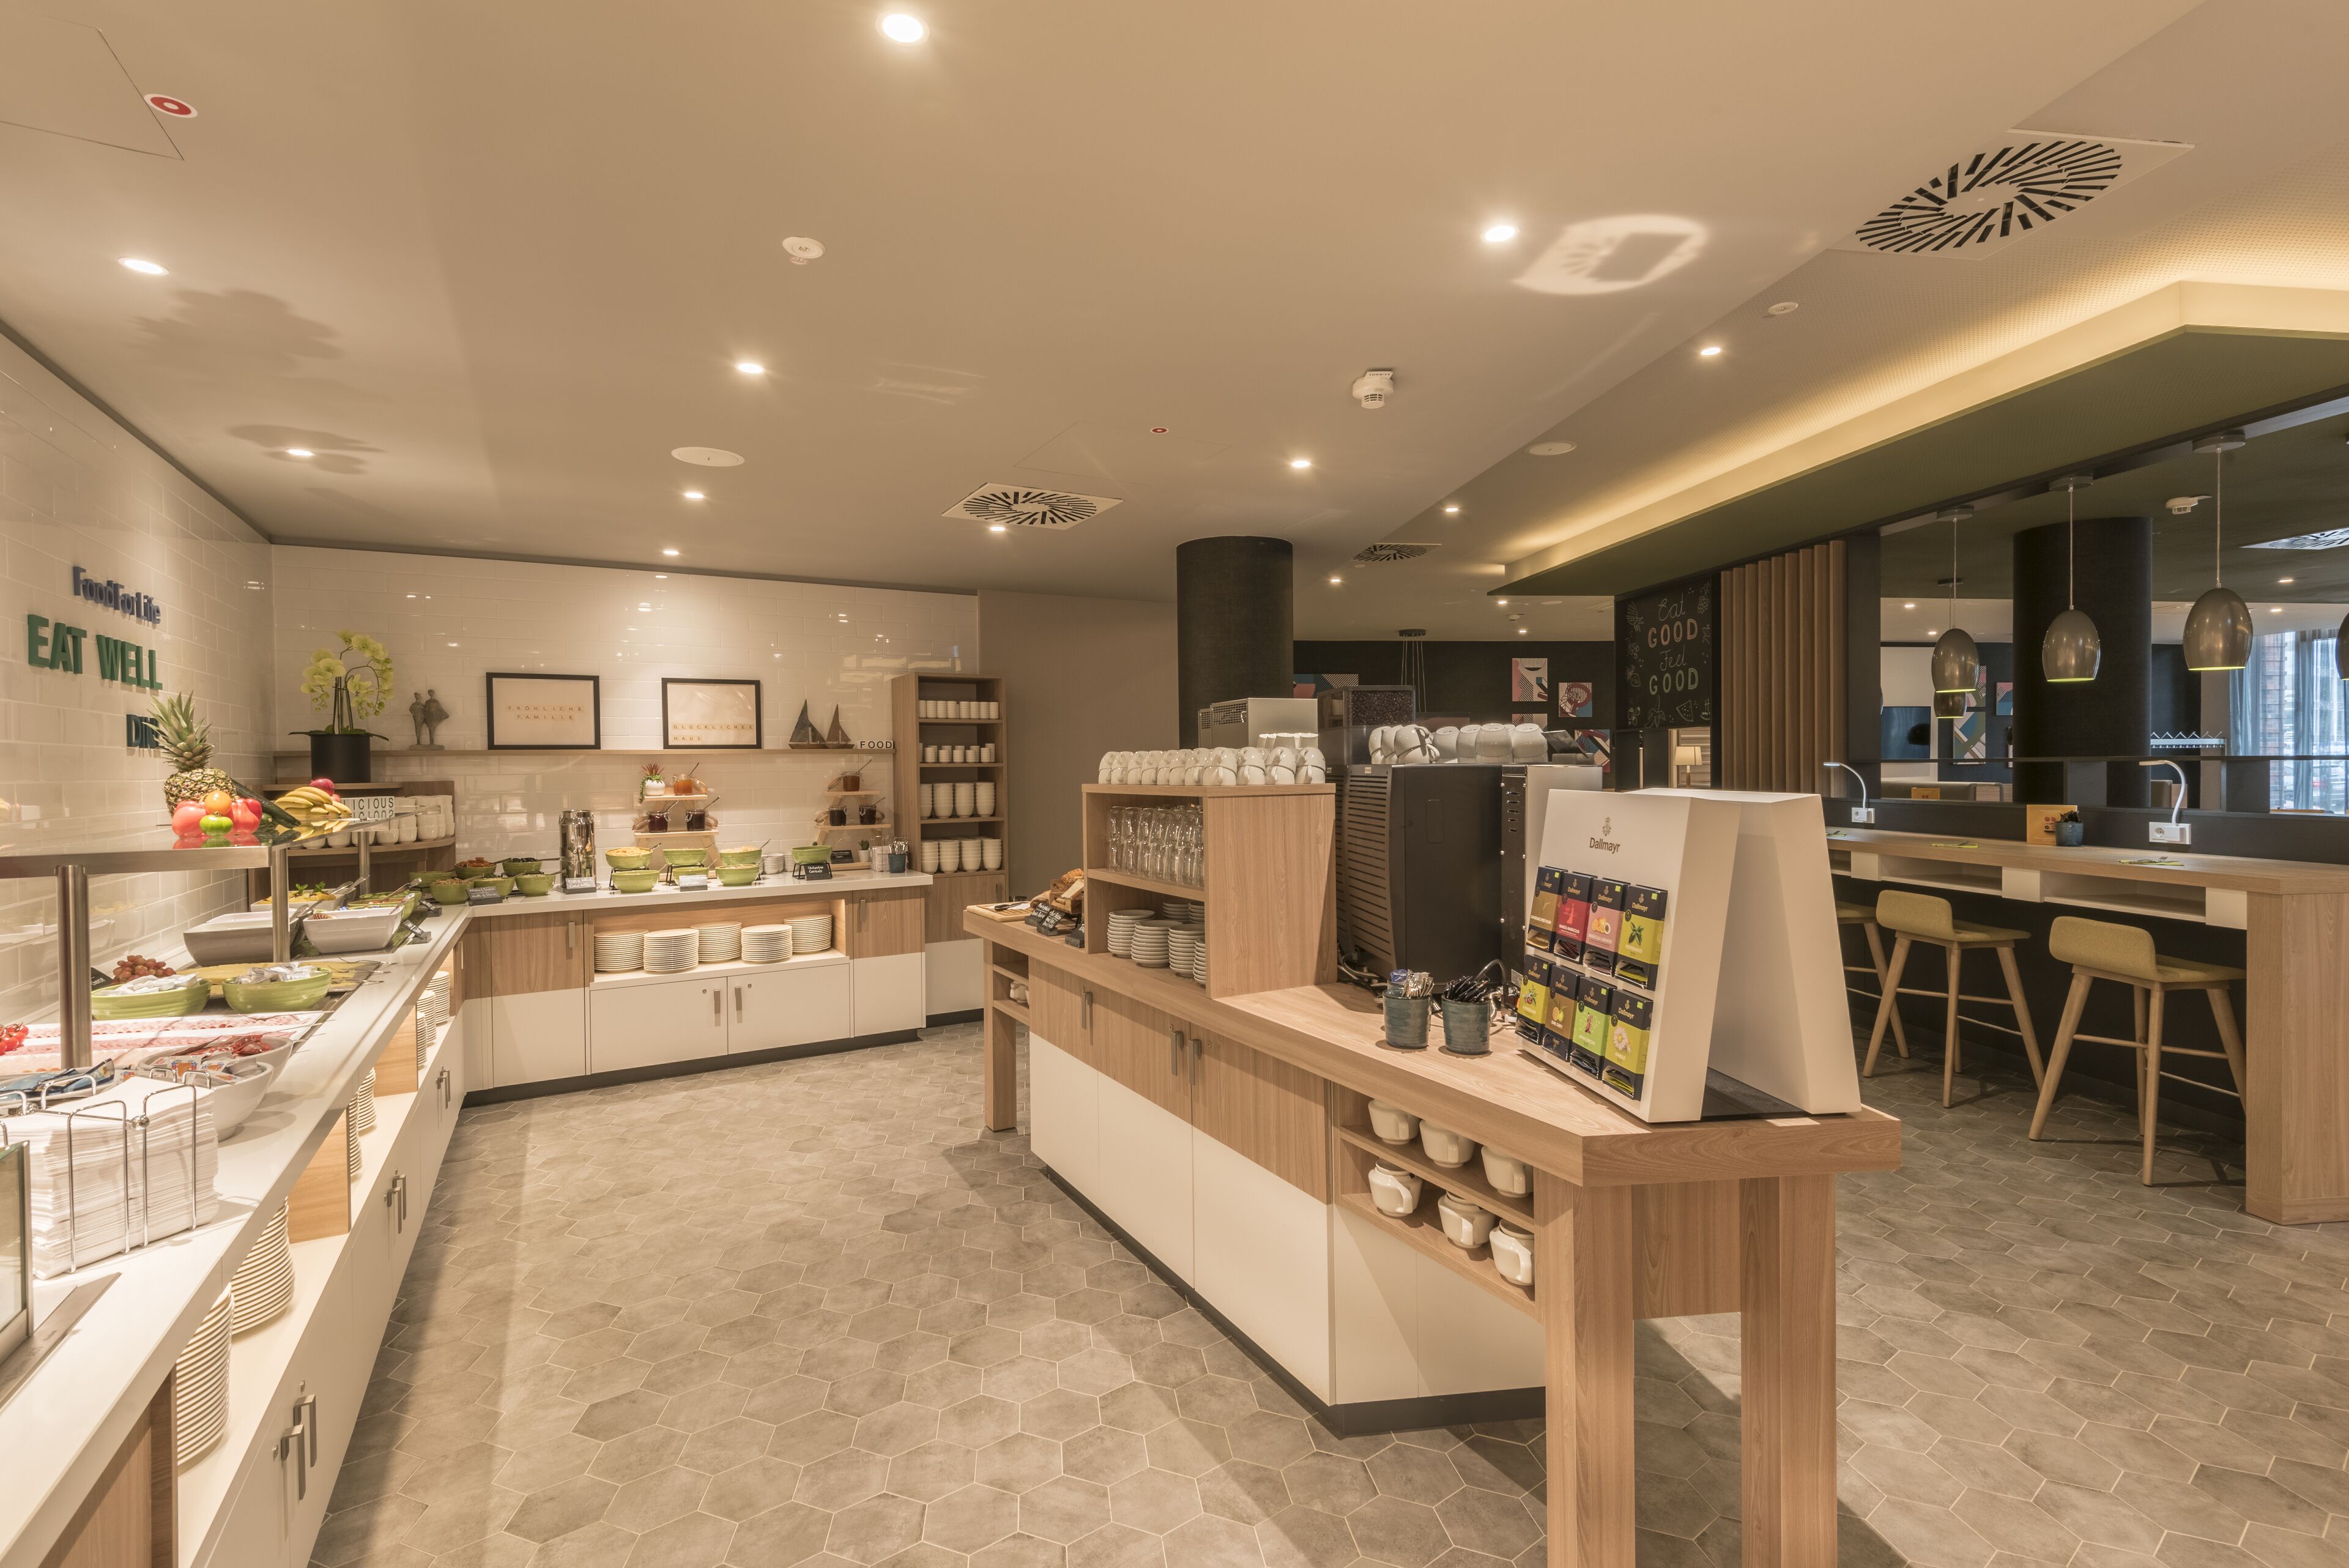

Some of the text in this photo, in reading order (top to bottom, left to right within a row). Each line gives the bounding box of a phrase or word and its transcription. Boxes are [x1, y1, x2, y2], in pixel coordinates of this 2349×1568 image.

[1658, 592, 1686, 621] Eat
[1648, 619, 1698, 648] GOOD
[28, 614, 163, 690] EAT WELL
[1660, 644, 1687, 671] Feel
[1649, 667, 1698, 696] GOOD
[1589, 837, 1620, 854] Dallmayr
[1598, 894, 1613, 903] Dallmayr
[1632, 902, 1648, 912] Dallmayr
[1618, 1007, 1634, 1019] Dallmayr
